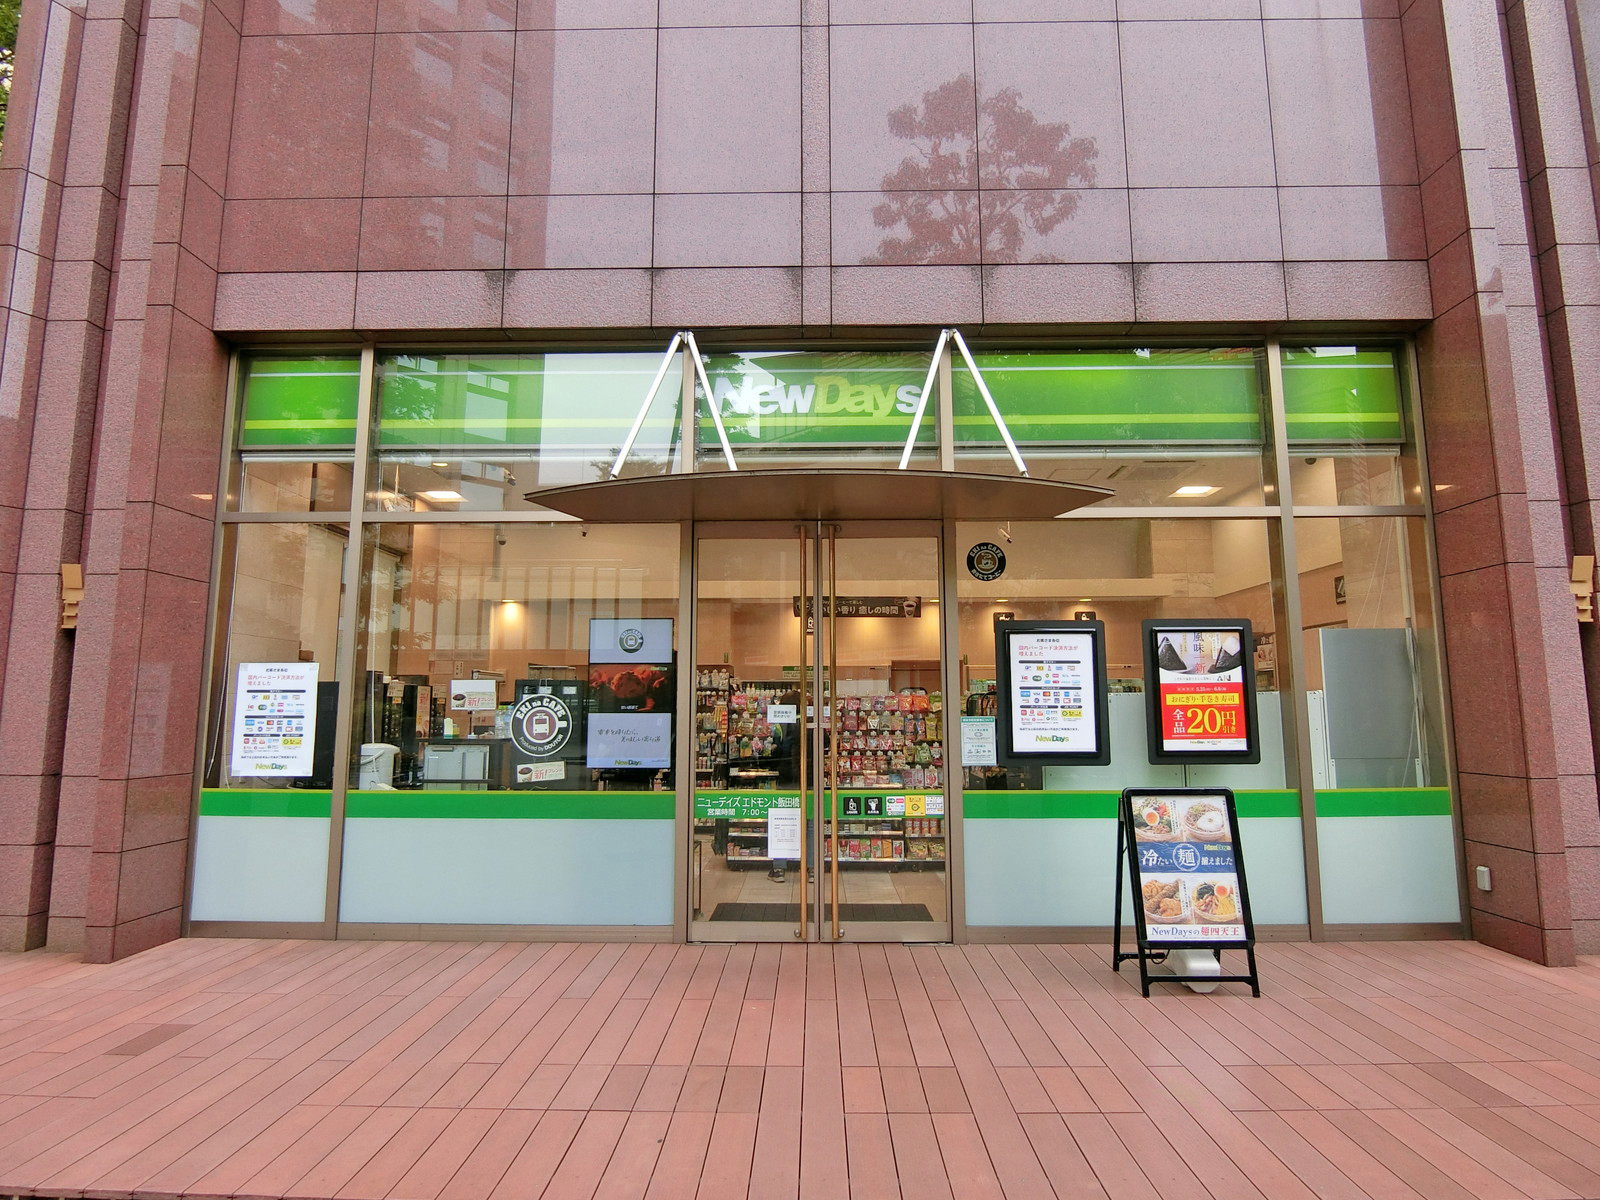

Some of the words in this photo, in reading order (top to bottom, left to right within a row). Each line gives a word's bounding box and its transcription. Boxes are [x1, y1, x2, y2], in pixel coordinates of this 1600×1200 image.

[713, 376, 922, 417] NewDays
[858, 606, 899, 615] 癒しの時間
[515, 701, 532, 720] EKI
[543, 698, 566, 718] CAFE
[1172, 708, 1185, 734] 全品
[519, 736, 538, 751] Produced
[544, 734, 564, 750] DOUTOR
[697, 796, 740, 808] ニューデイズ
[742, 796, 800, 808] エドモント飯田橋
[707, 808, 736, 816] 営業時間
[1142, 849, 1172, 866] 冷たい
[1177, 848, 1196, 866] 麺
[1201, 857, 1233, 866] 揃えました
